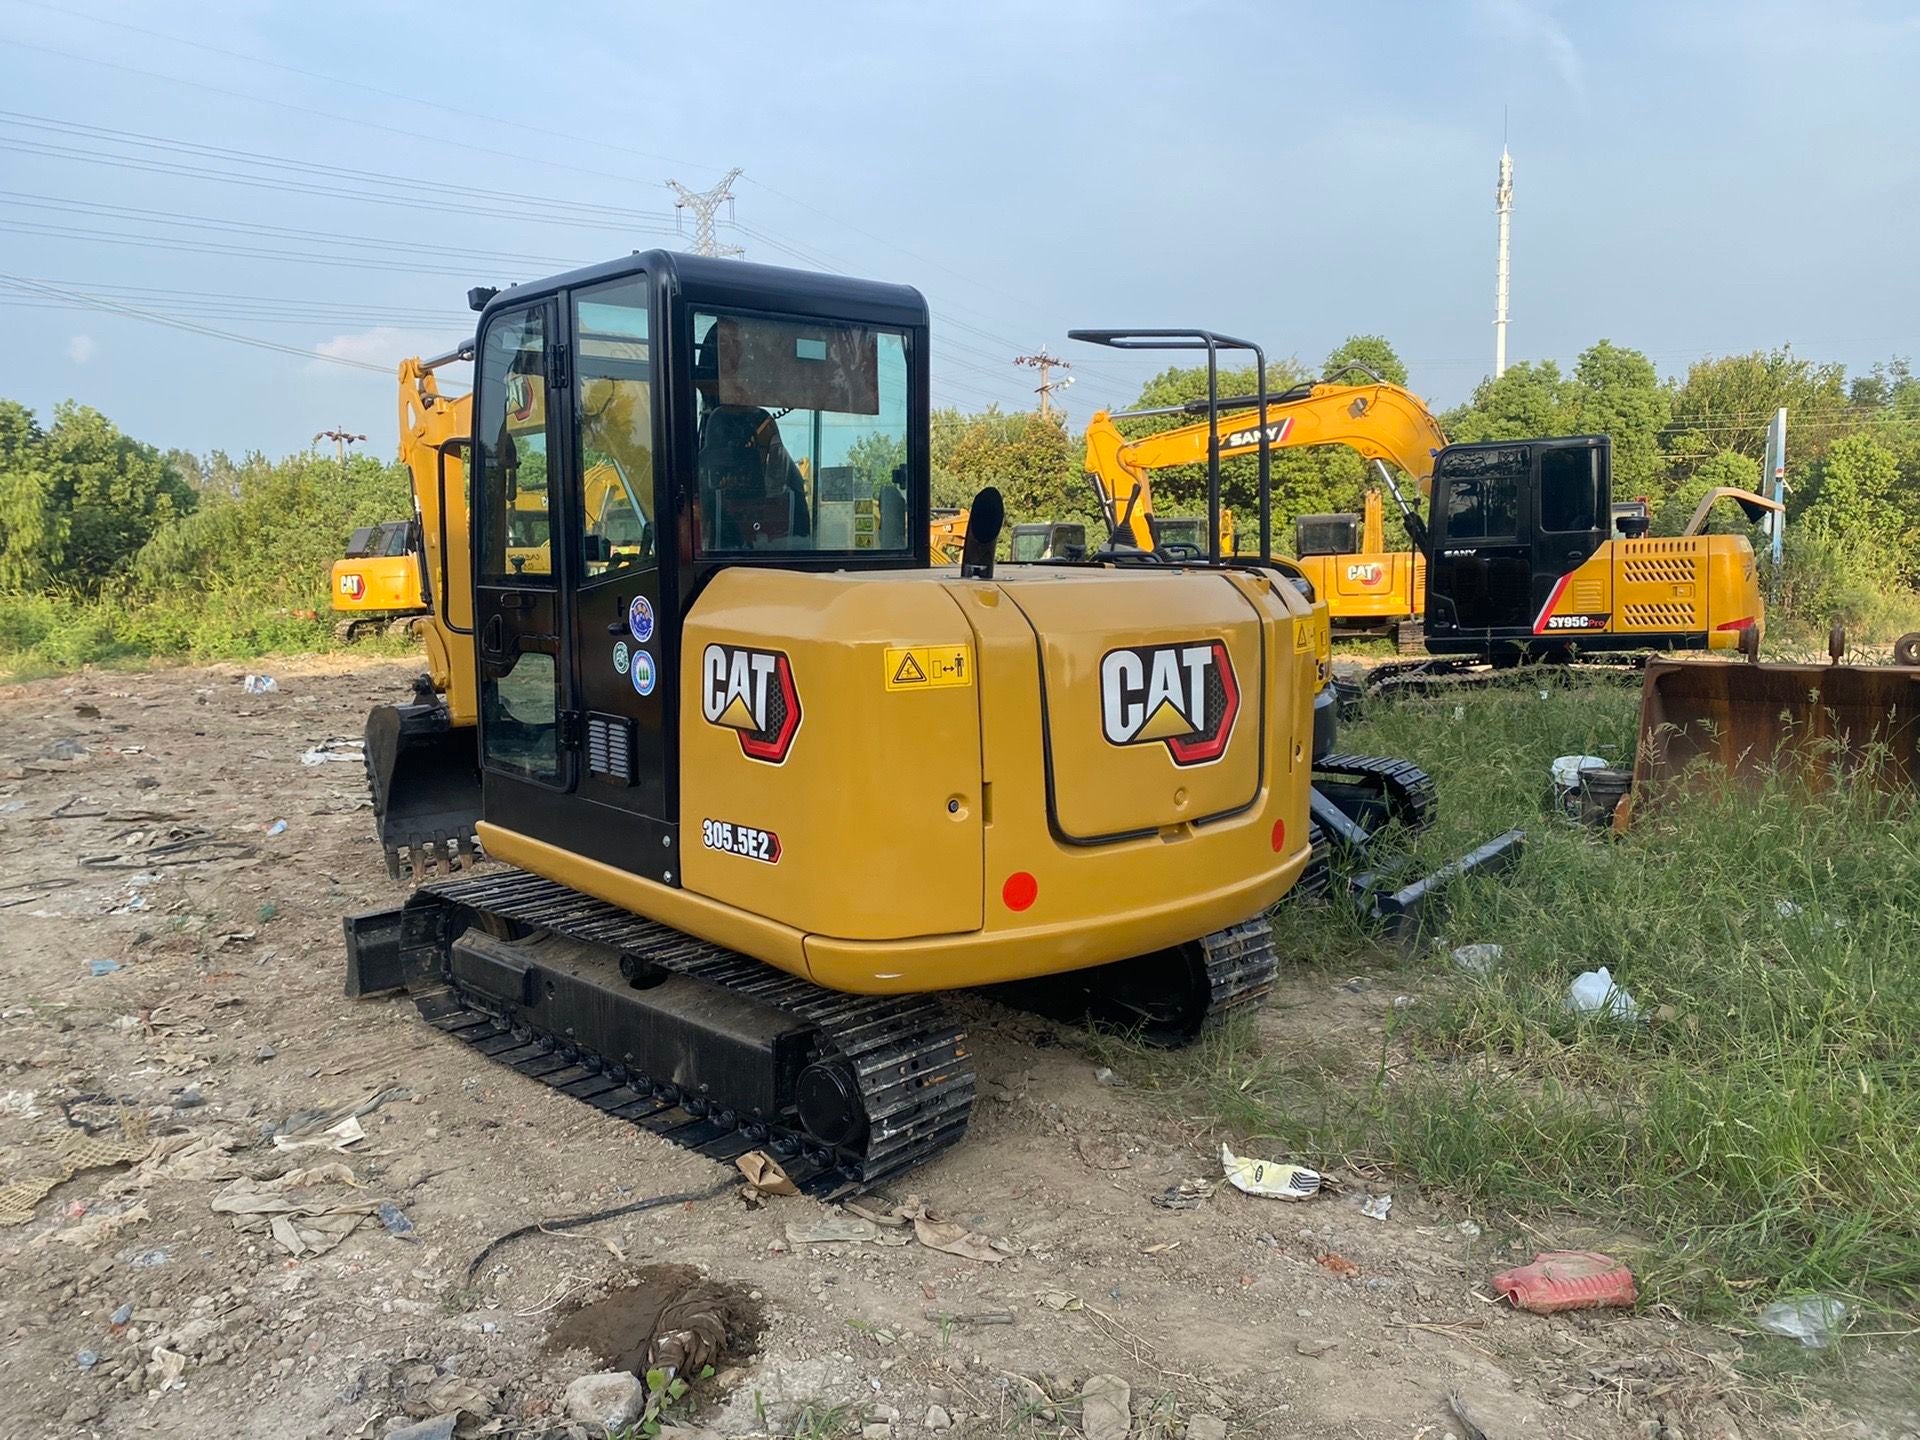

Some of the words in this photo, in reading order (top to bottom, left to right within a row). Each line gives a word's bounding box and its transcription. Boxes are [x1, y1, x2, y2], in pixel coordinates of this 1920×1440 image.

[340, 575, 358, 595] CAT
[1347, 564, 1375, 581] CAT
[1549, 616, 1589, 628] SY95C
[1589, 619, 1605, 628] Pro
[703, 644, 775, 732] CAT
[1102, 645, 1212, 743] CAT
[703, 820, 769, 860] 305.5E2
